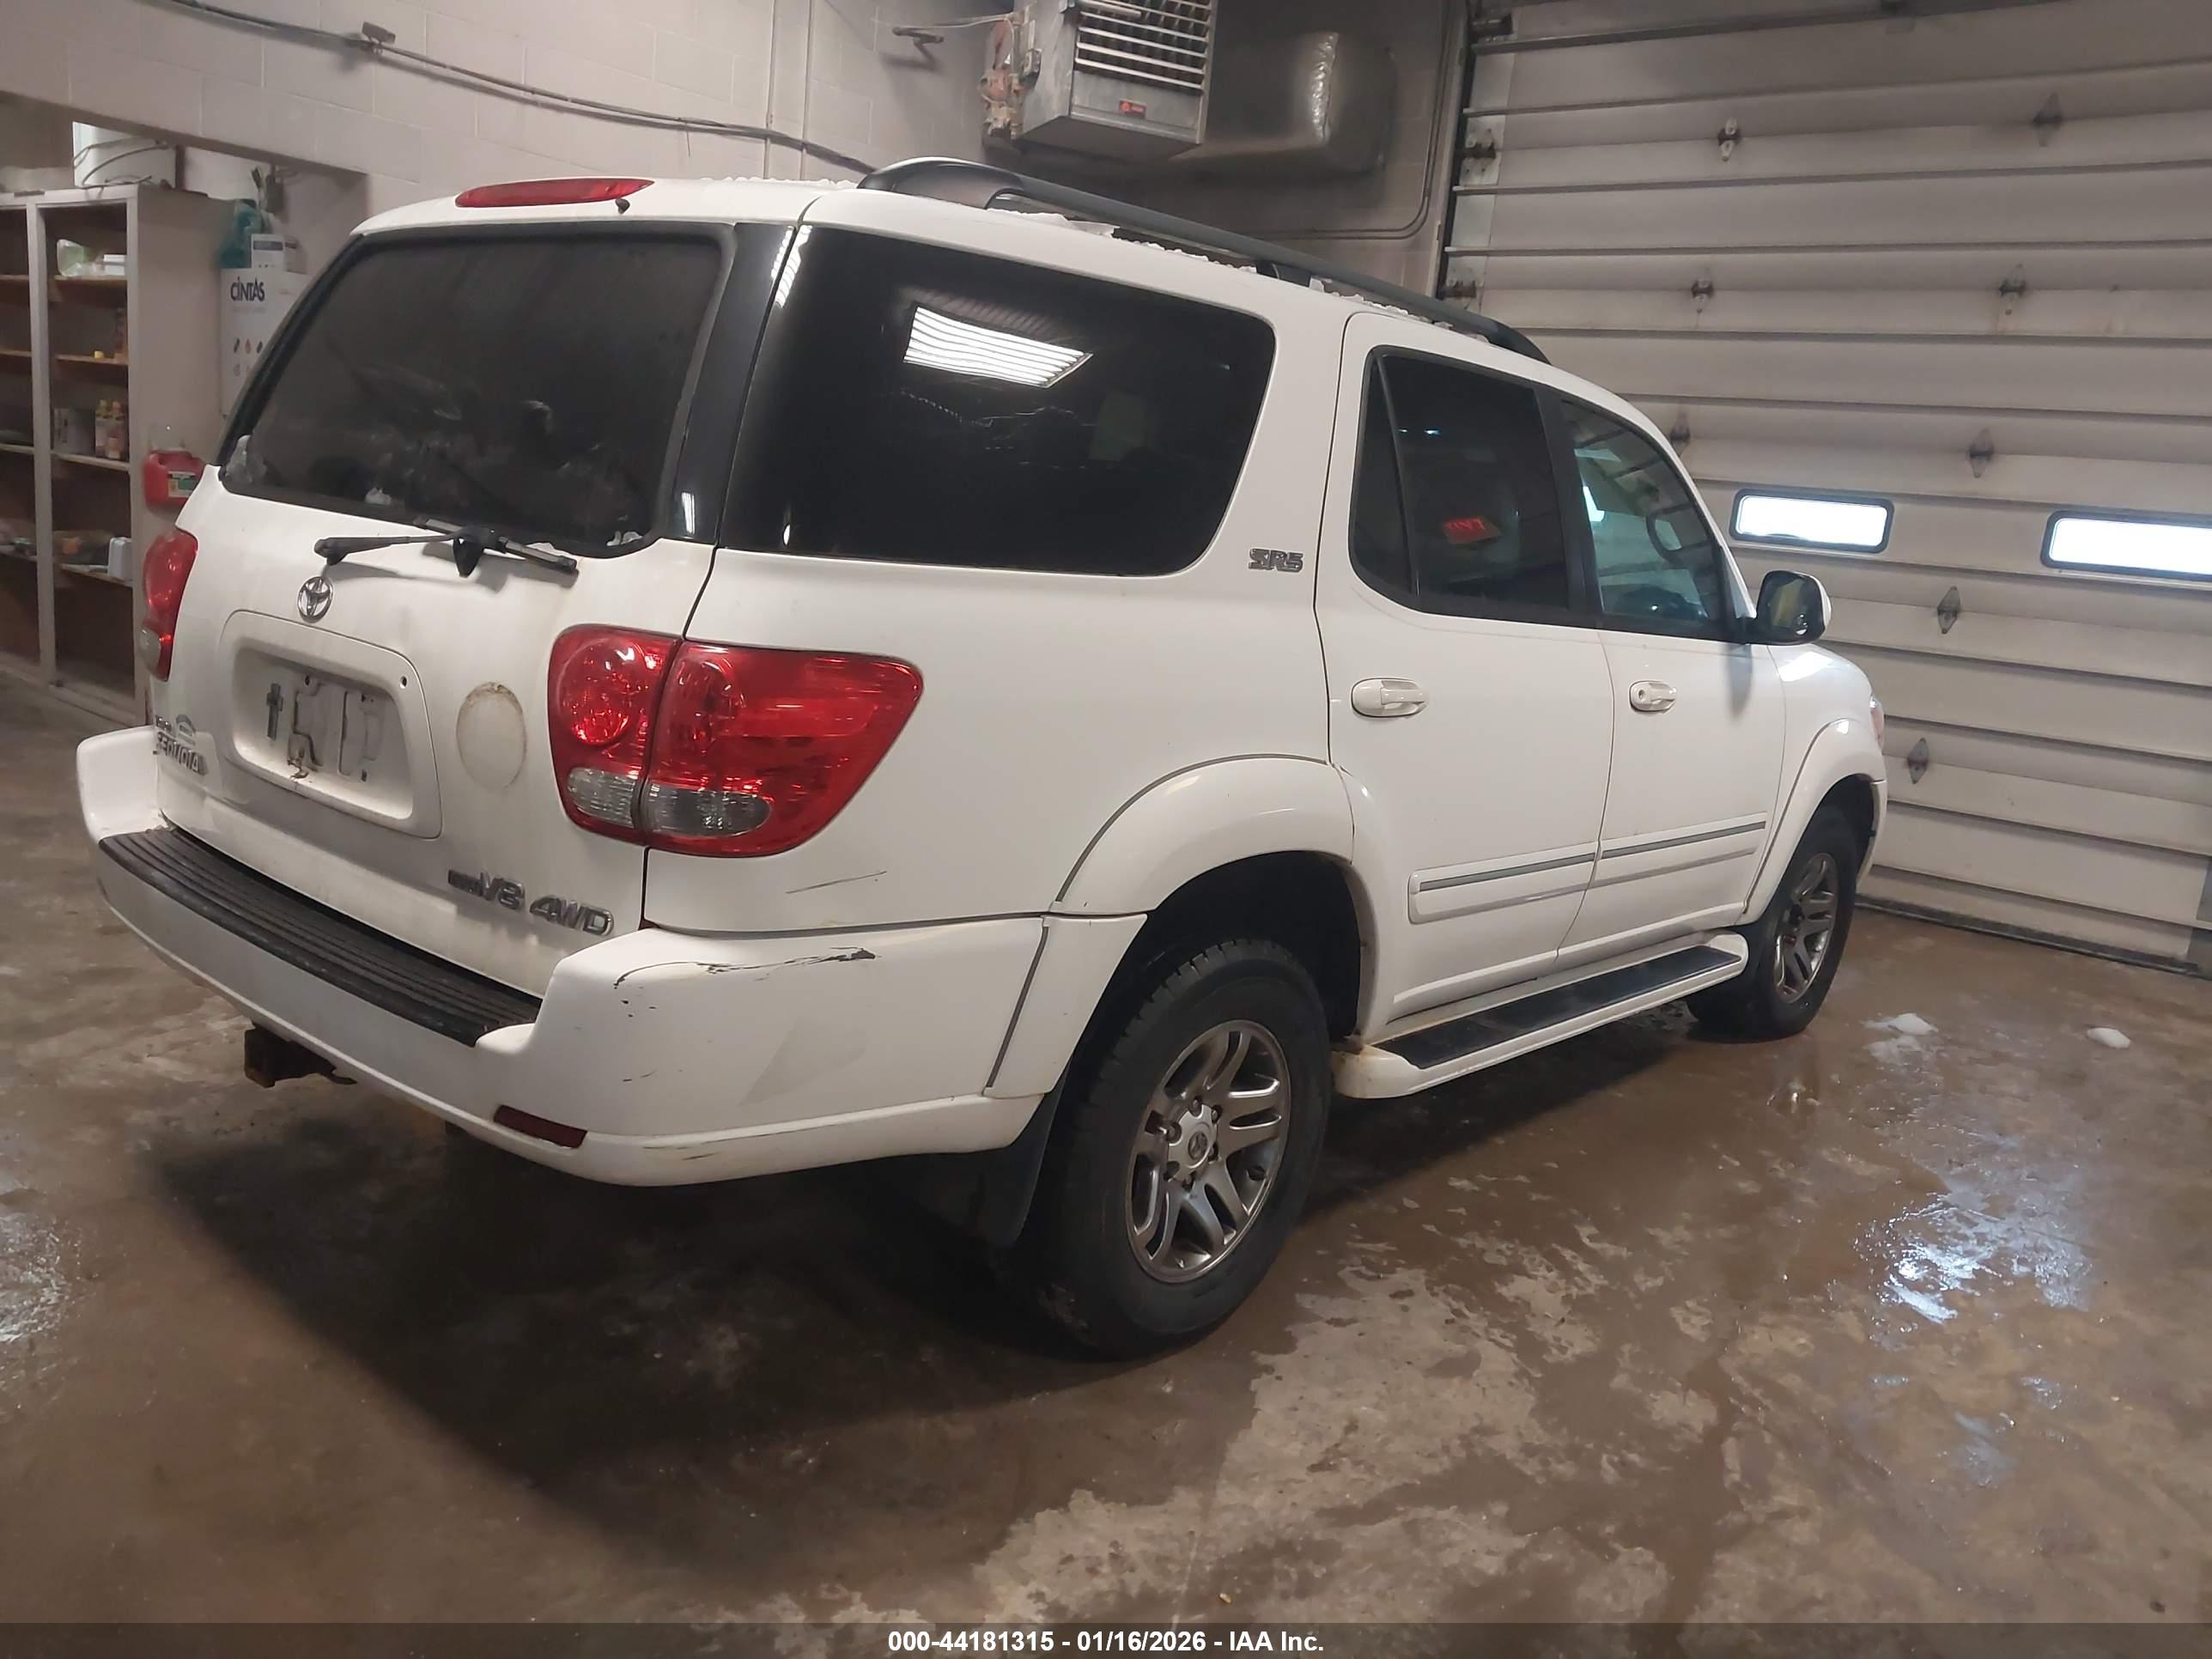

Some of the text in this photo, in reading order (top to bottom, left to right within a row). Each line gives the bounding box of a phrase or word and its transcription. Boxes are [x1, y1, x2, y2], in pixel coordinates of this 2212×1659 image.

[1248, 548, 1304, 573] SR5
[479, 869, 525, 911] V8
[529, 895, 614, 937] 4WD
